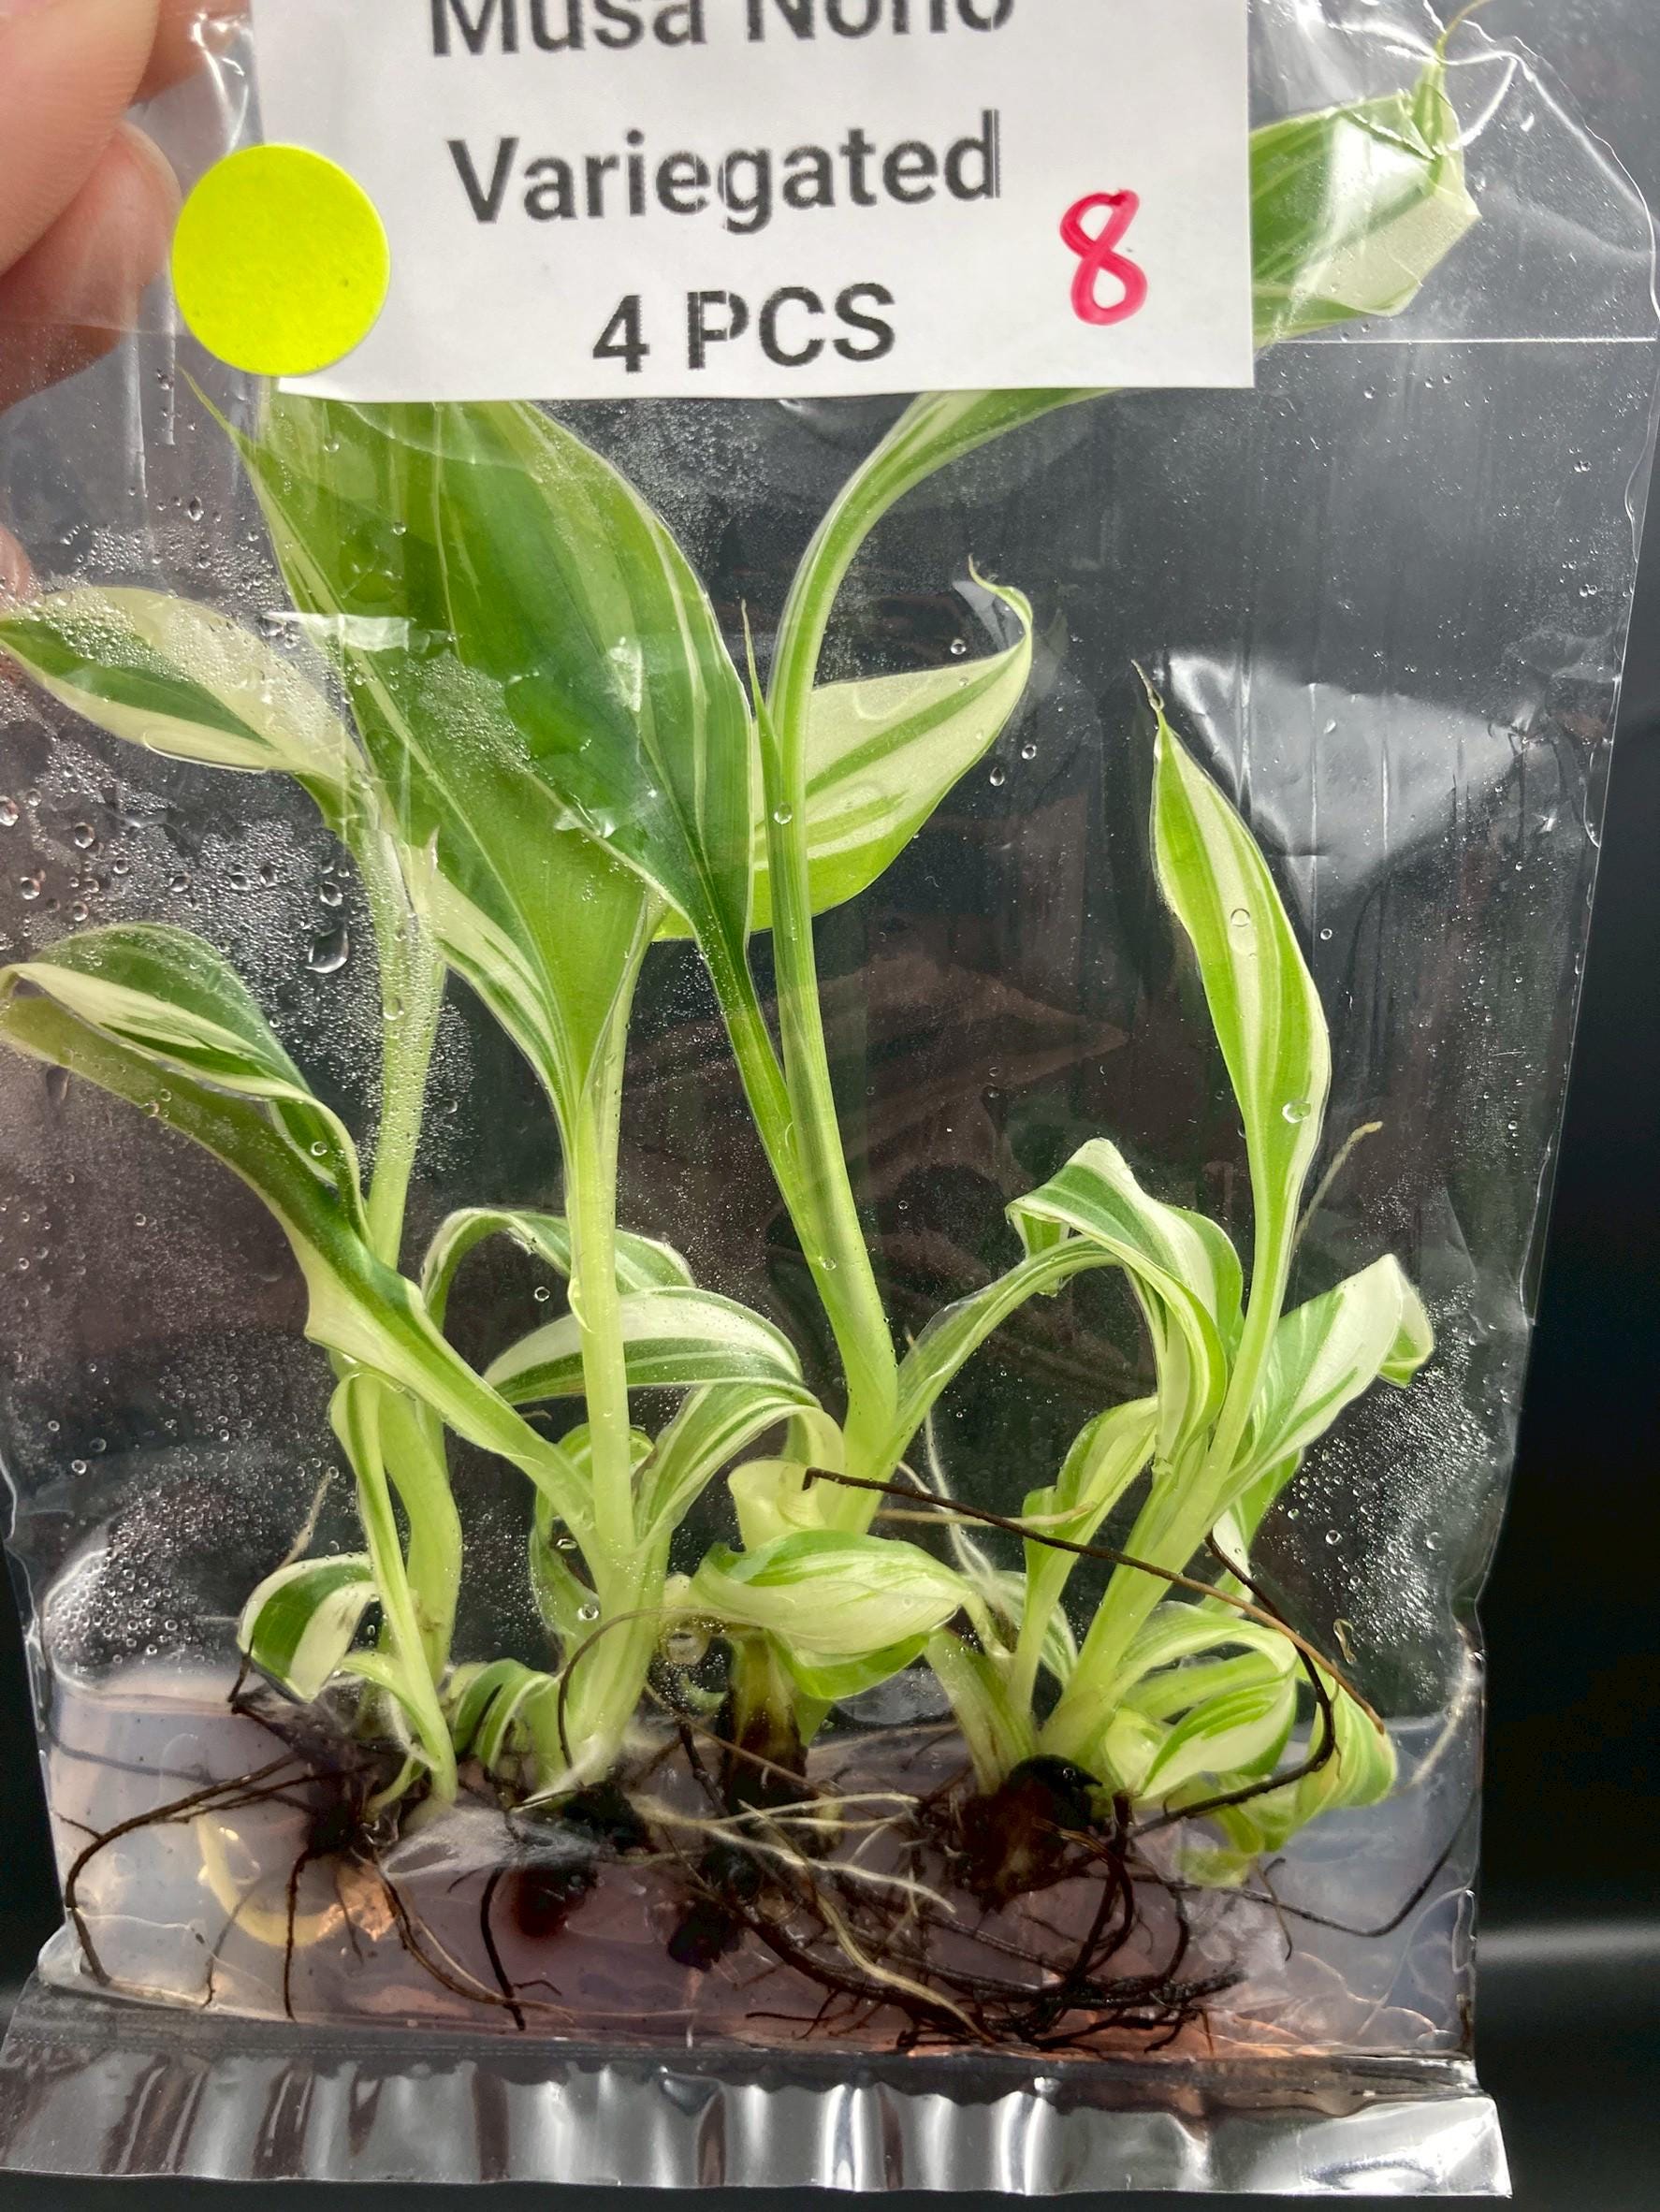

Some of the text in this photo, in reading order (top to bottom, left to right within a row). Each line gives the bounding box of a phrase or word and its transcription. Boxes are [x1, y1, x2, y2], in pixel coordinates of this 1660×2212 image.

[430, 0, 706, 56] Musa
[448, 109, 1000, 235] Variegated
[1059, 188, 1147, 326] 8
[592, 283, 896, 372] 4 PCS
